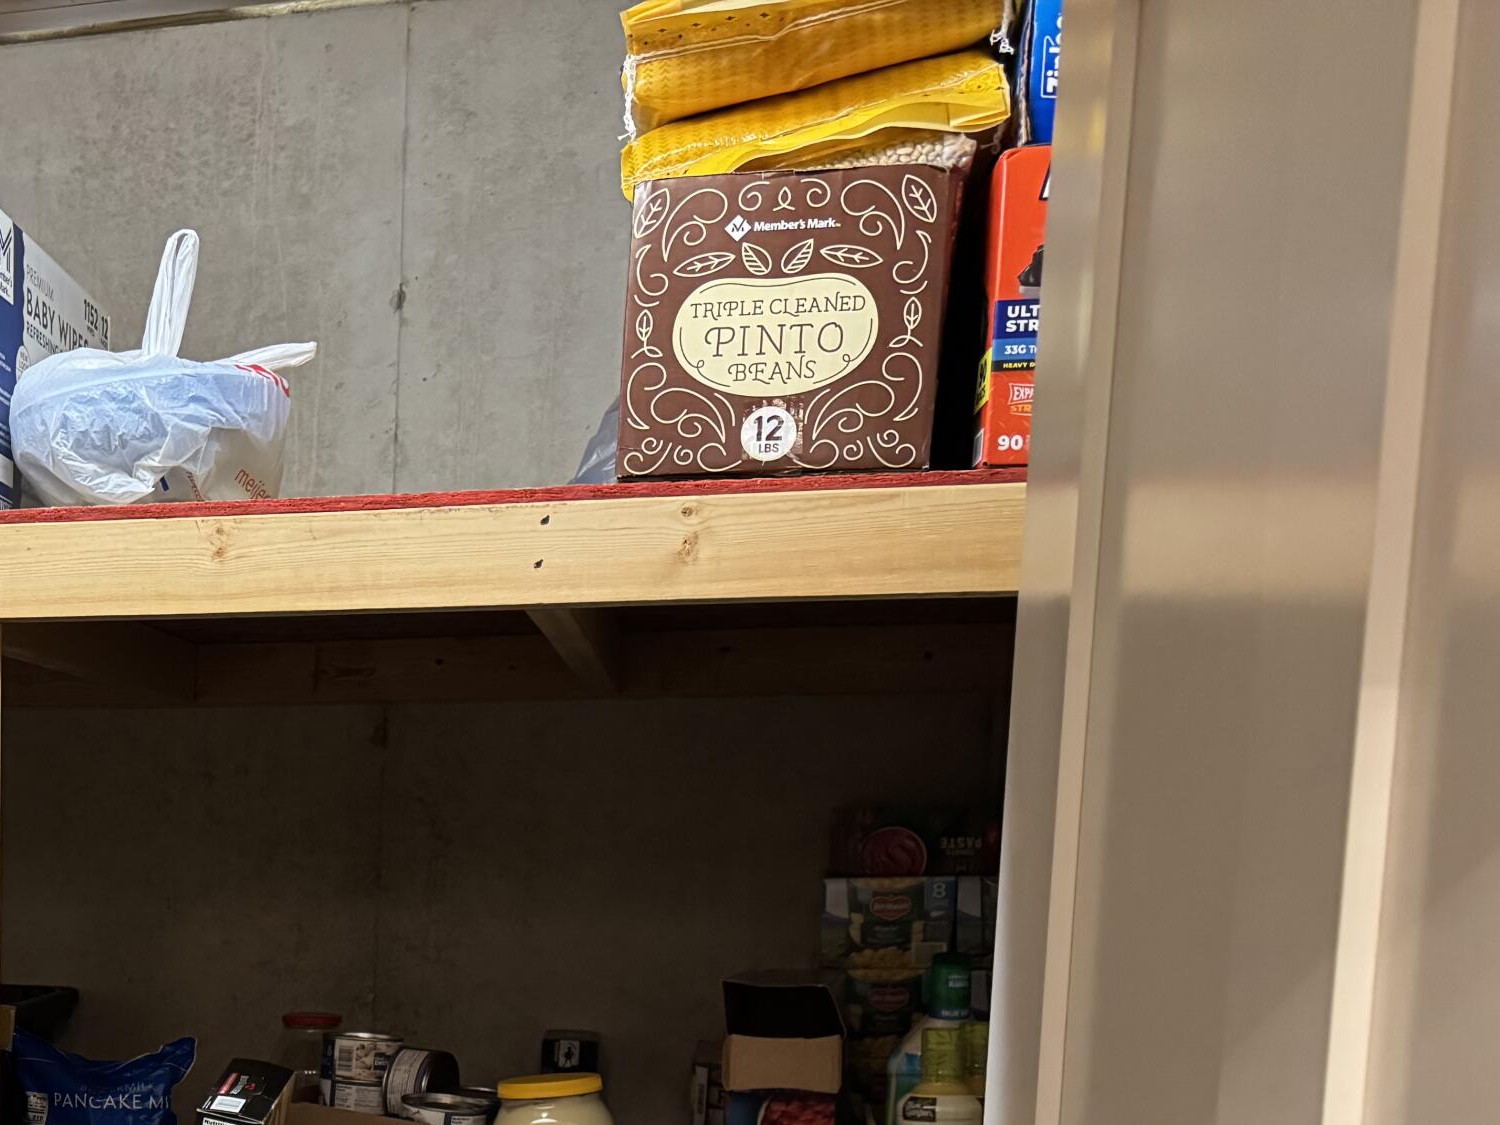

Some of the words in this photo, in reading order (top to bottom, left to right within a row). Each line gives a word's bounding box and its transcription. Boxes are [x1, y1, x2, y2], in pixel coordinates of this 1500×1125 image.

[753, 218, 806, 232] Member's
[806, 217, 836, 229] Mark
[26, 286, 56, 336] BABY
[83, 299, 99, 332] 1152
[690, 299, 764, 321] TRIPLE
[769, 291, 866, 317] CLEANED
[704, 321, 844, 357] PINTO
[1004, 344, 1026, 355] 33G
[727, 355, 817, 385] BEANS
[753, 414, 785, 443] 12
[997, 434, 1024, 451] 90
[758, 443, 780, 454] LBS
[53, 1092, 142, 1110] PANCAKE
